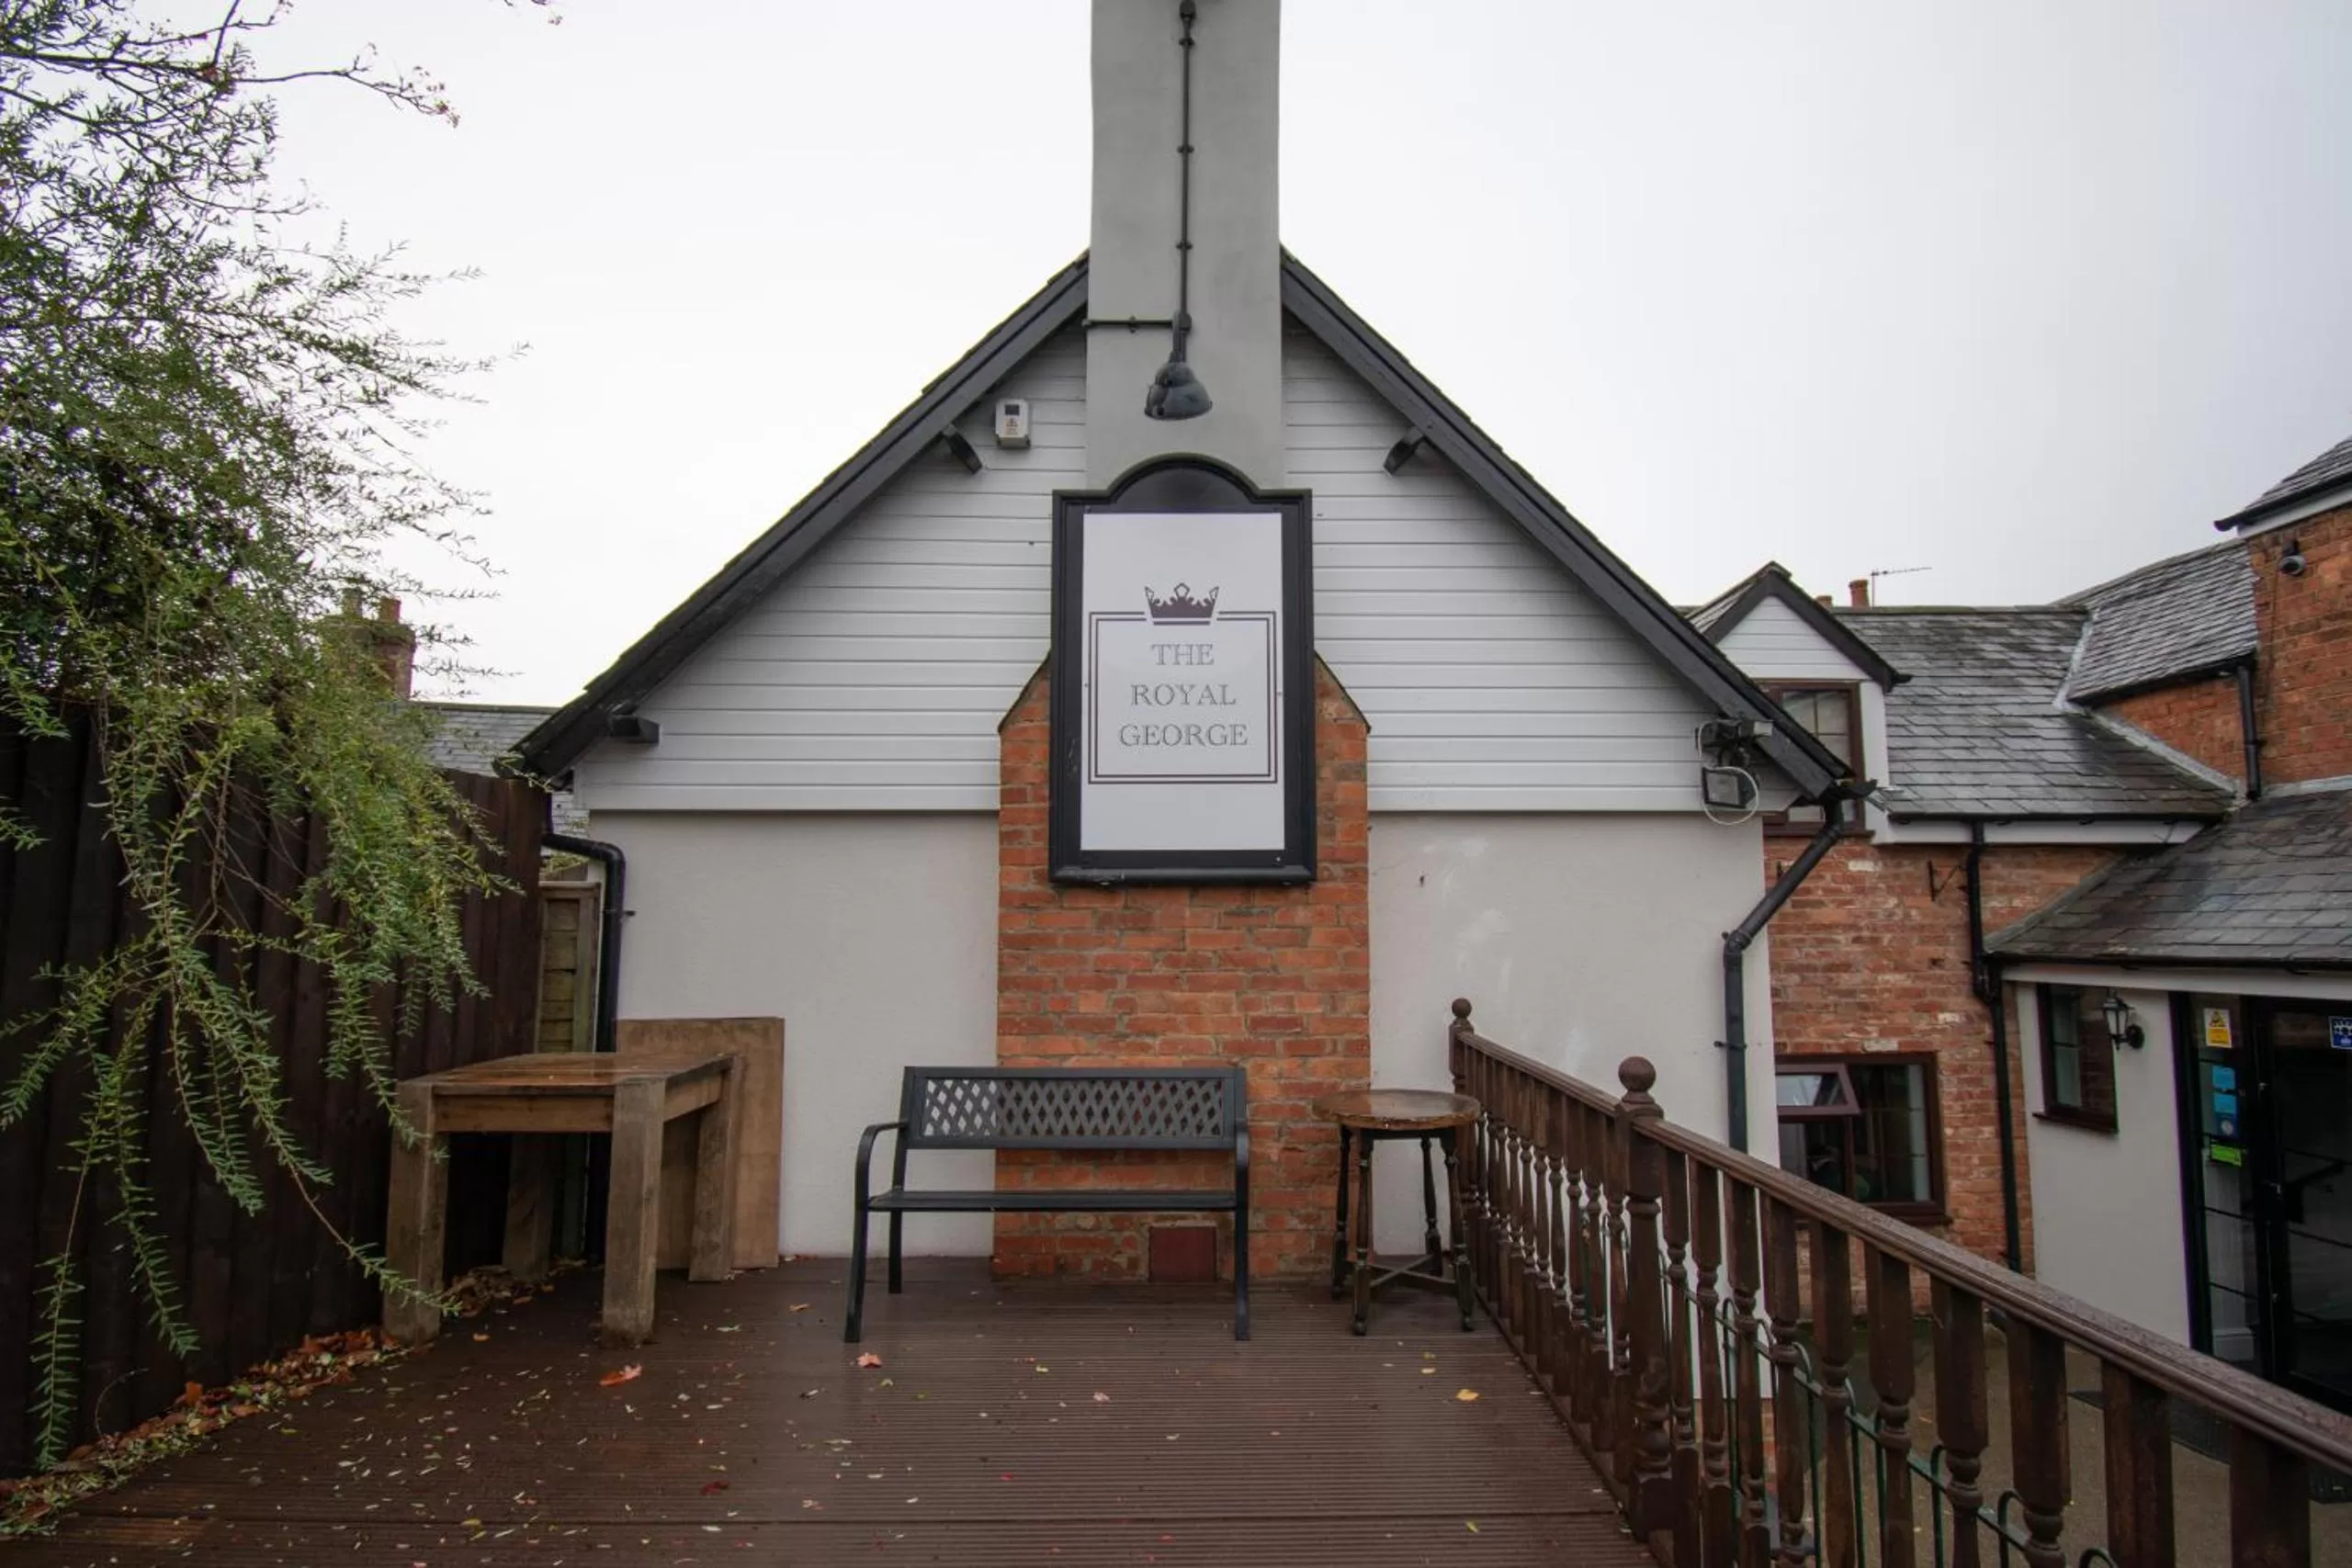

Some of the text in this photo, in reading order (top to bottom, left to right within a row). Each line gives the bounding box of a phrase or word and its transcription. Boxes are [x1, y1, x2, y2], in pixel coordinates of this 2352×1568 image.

[1151, 643, 1215, 666] THE
[1130, 683, 1237, 706] ROYAL
[1119, 723, 1249, 748] GEORGE
